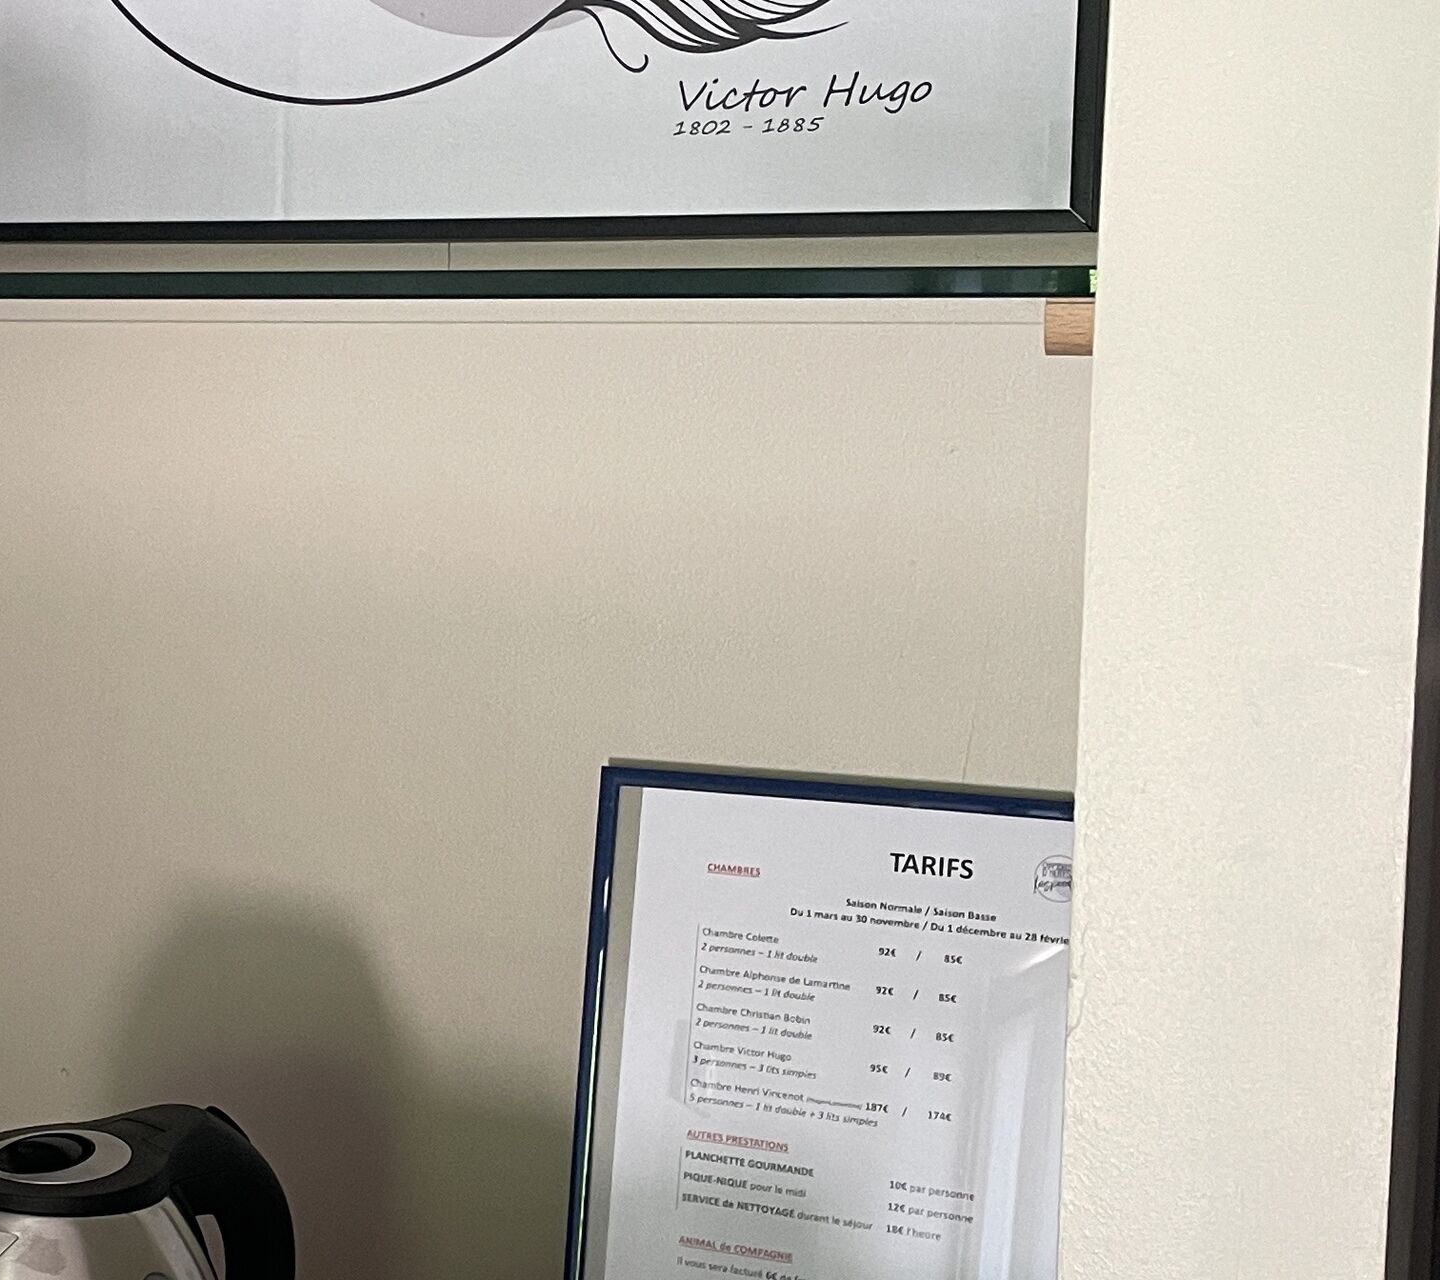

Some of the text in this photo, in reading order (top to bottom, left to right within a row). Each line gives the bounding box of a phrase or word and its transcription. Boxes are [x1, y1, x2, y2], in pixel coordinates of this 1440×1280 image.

[679, 71, 932, 113] Victor Hugo
[673, 120, 730, 136] 1802
[762, 117, 824, 133] 1885
[708, 863, 760, 877] CHAMBRES
[890, 853, 974, 880] TARIFS
[846, 898, 996, 921] Saison Normale Saison Basse
[790, 908, 1070, 945] Du mars au 30 novembre Du décembre au 28 févrie
[702, 927, 963, 964] Chambre Colette 92€ 85€
[709, 945, 818, 963] personnes double
[700, 965, 957, 1003] Chambre Alphonse de Lamartine 92€ 85€
[705, 982, 816, 1001] personnes double
[696, 1003, 954, 1042] Chambre Christian Bobin 92€ 85€
[703, 1020, 812, 1039] personnes double
[694, 1041, 952, 1082] Chambre Victor Hugo 95€ 89€
[700, 1057, 746, 1071] personnes
[690, 1078, 731, 1091] Chambre
[735, 1084, 760, 1095] Henri
[866, 1102, 889, 1113] 187€
[928, 1111, 952, 1121] 174€
[697, 1096, 744, 1108] personnes
[687, 1129, 789, 1152] AUTRES PRESTATIONS
[686, 1150, 974, 1201] PLANCHETTE GOURMANDE 10€ par personne
[684, 1172, 748, 1189] PIQUE-NIQUE
[750, 1183, 772, 1192] pour
[786, 1188, 806, 1197] midi
[888, 1203, 905, 1213] 12€
[908, 1207, 924, 1216] par
[927, 1210, 973, 1223] personne
[682, 1193, 720, 1206] SERVICE
[723, 1199, 734, 1208] de
[737, 1201, 794, 1218] NETTOYAGE
[797, 1211, 829, 1223] durant
[886, 1225, 903, 1235] 18€
[734, 1244, 792, 1262] COMPAGNIE
[766, 1271, 777, 1280] 6€
